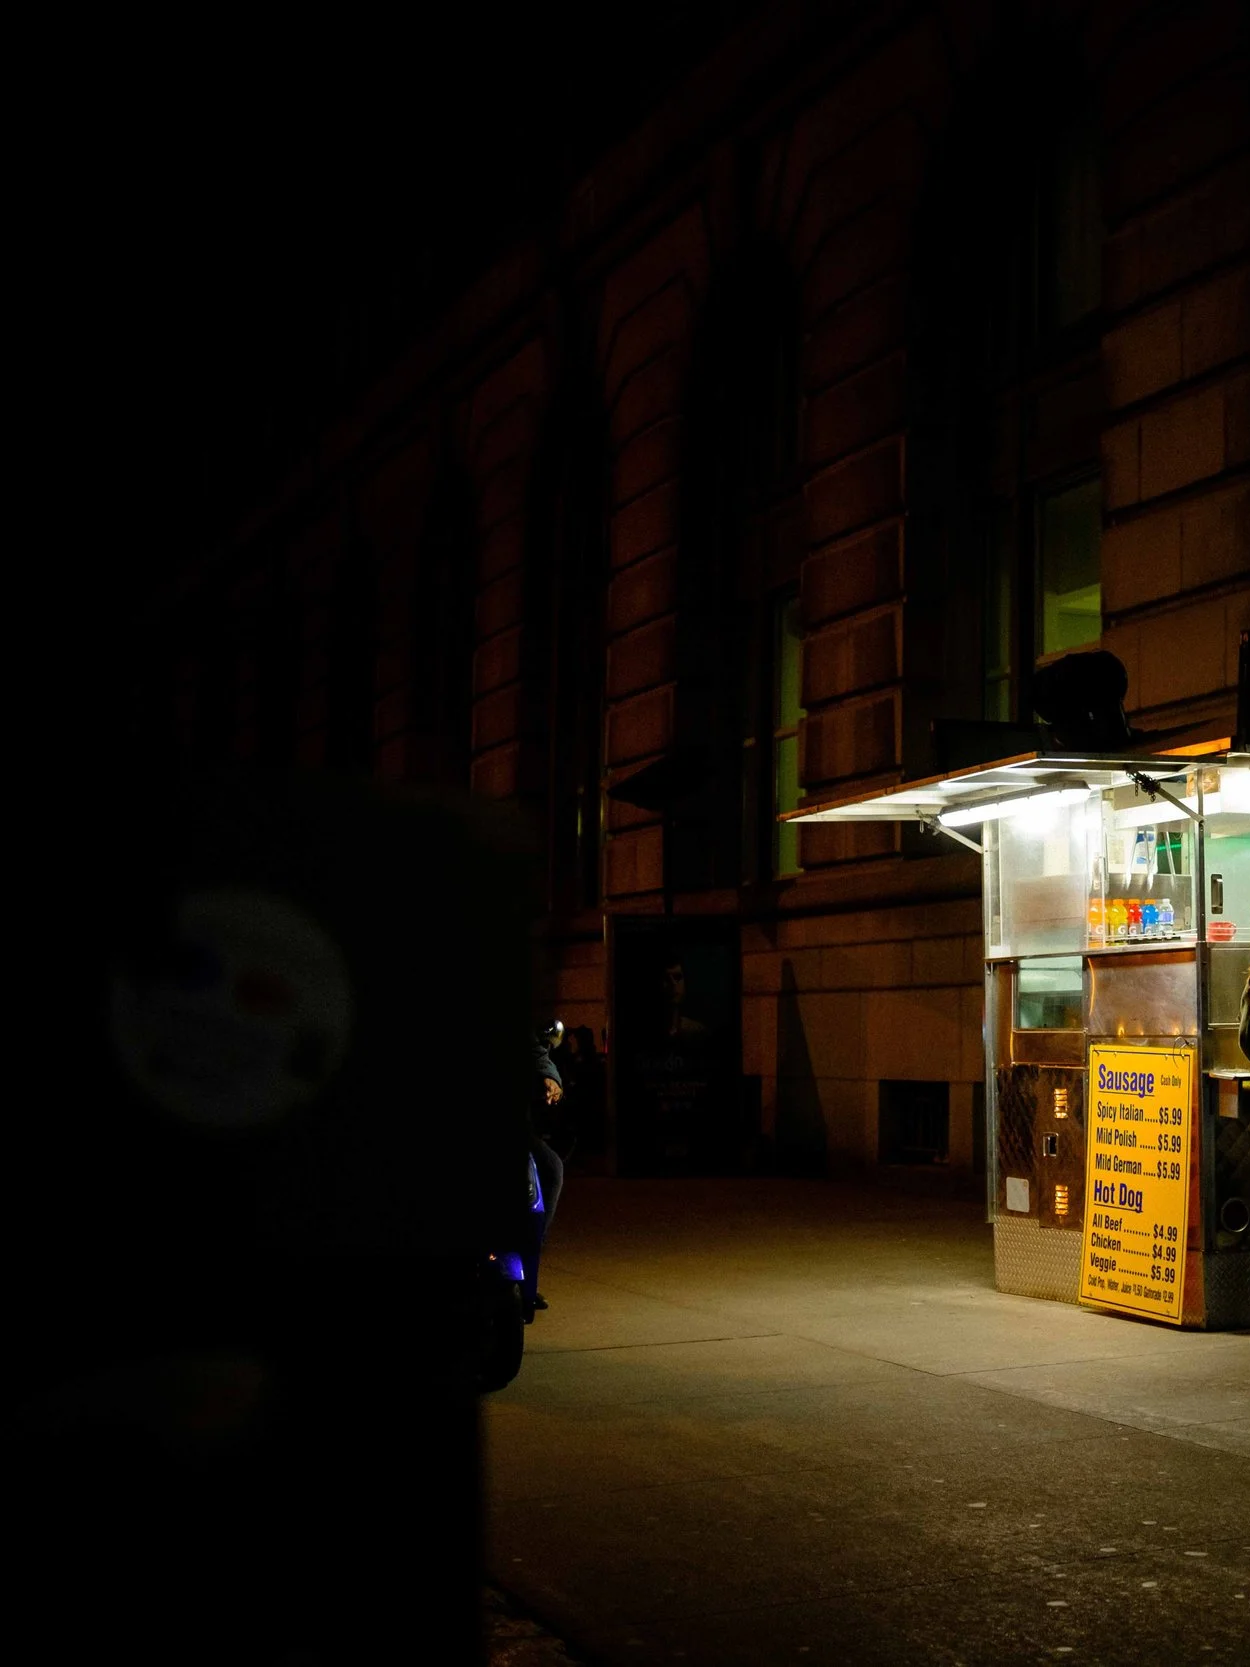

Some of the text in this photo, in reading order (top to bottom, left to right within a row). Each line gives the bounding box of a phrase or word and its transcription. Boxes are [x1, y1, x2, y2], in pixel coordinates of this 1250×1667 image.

[1099, 1064, 1154, 1098] Sausage
[1097, 1101, 1182, 1126] Spicy Italian $5.99
[1096, 1127, 1181, 1153] Mild Polish $5.99
[1096, 1153, 1180, 1180] Mild German $5.99
[1094, 1180, 1143, 1213] Hot Dog
[1093, 1213, 1177, 1242] All Beef $4.99
[1091, 1232, 1176, 1262] Chicken $4.99
[1090, 1252, 1175, 1284] Veggie $5.99
